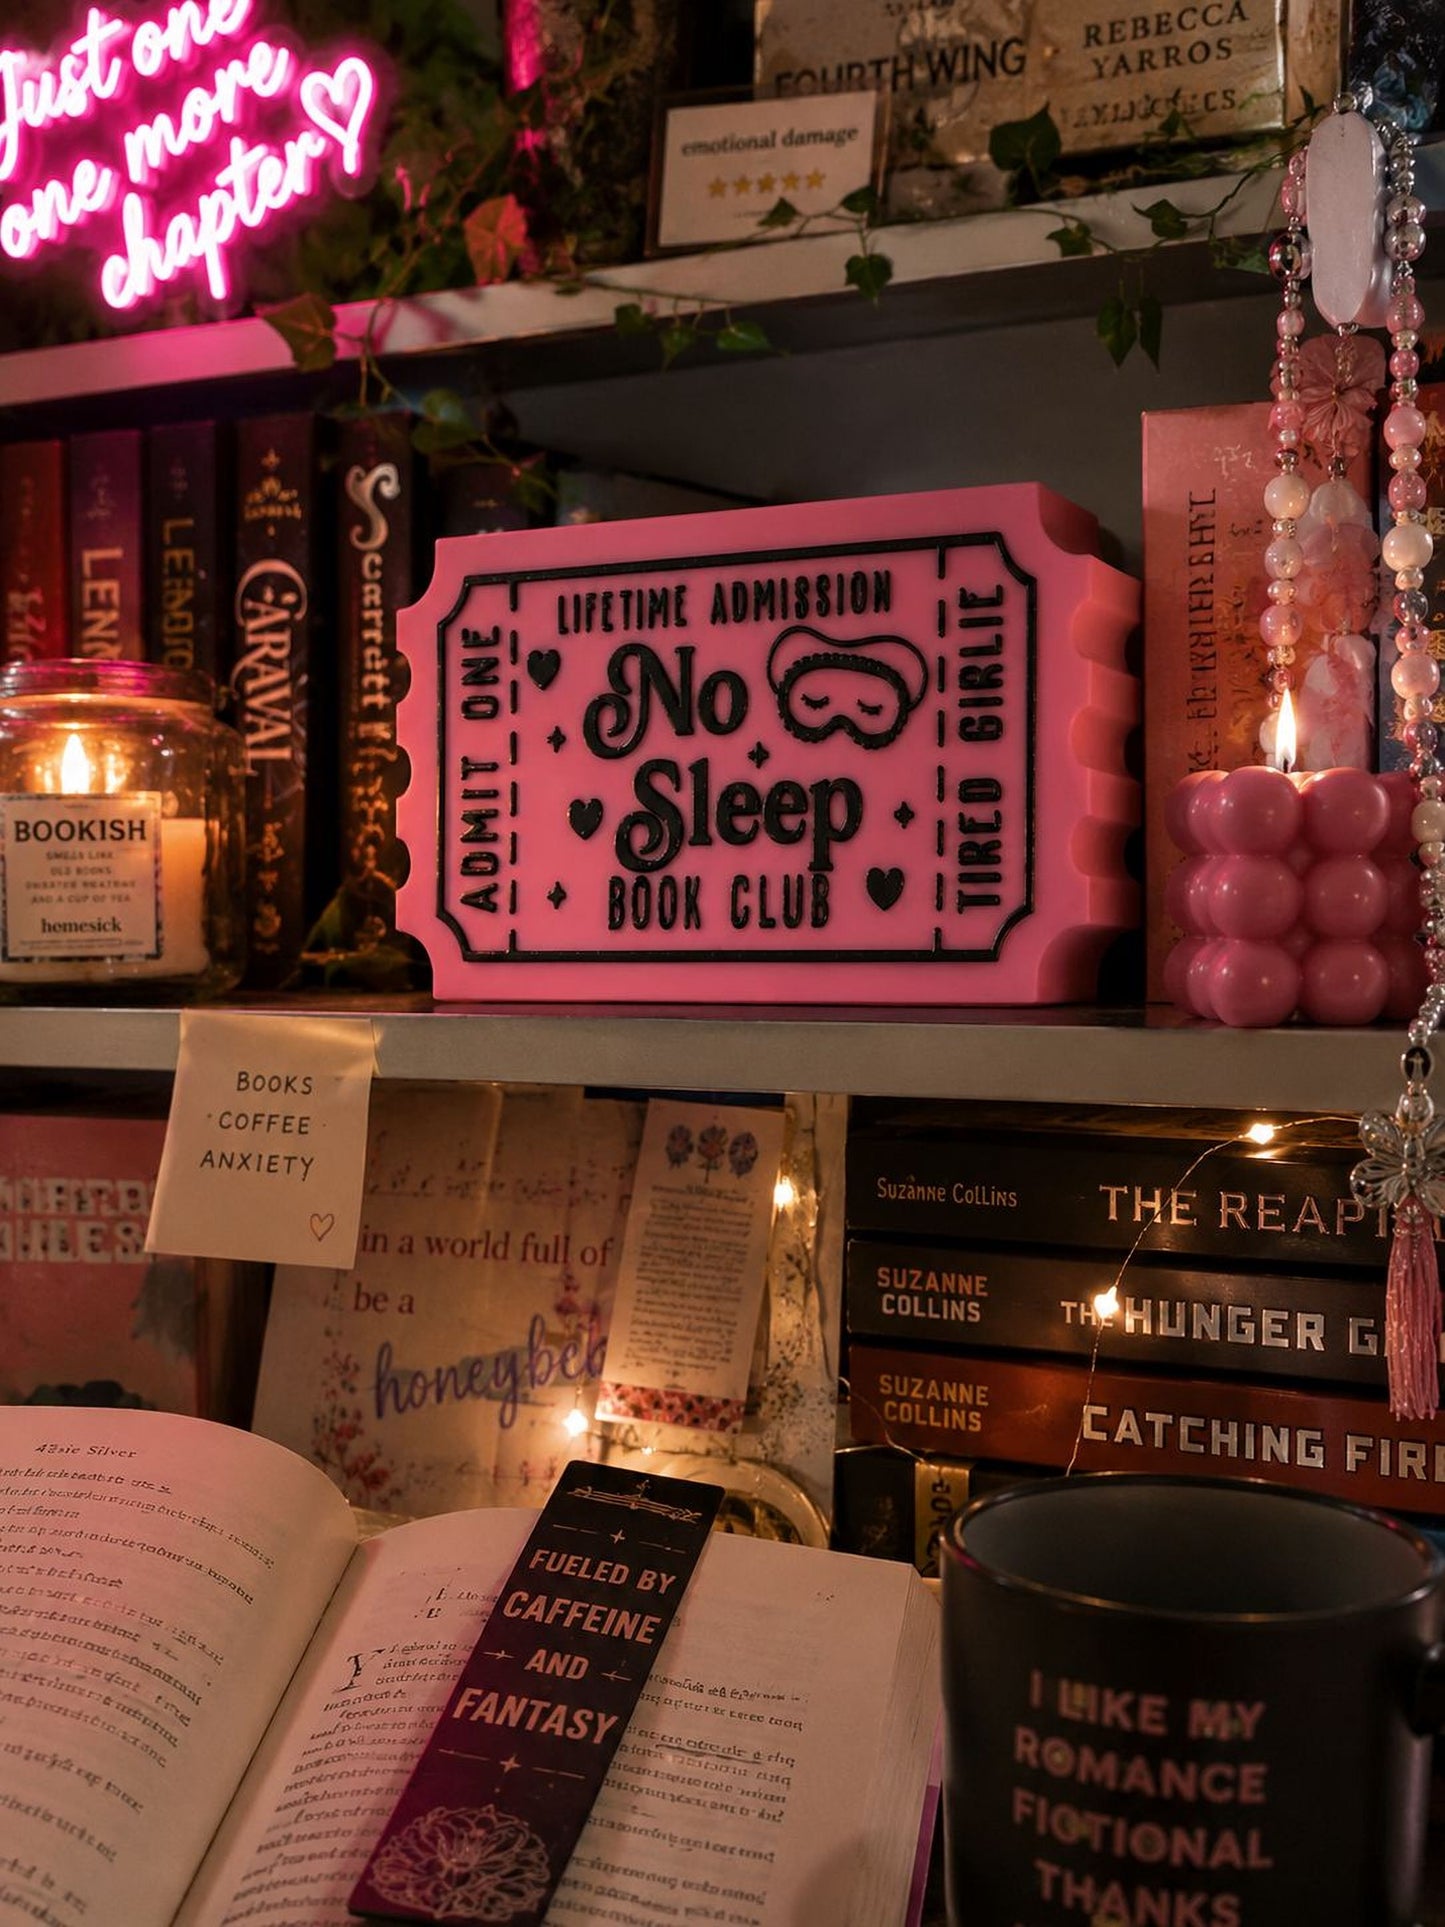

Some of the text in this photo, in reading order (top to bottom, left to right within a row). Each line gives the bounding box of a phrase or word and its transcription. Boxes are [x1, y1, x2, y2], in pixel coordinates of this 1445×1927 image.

[1083, 1, 1249, 48] REBECCA
[774, 37, 1027, 97] FOURTH WING
[1092, 38, 1233, 80] YARROS
[0, 0, 251, 181] Just one
[0, 41, 291, 259] one more
[681, 126, 858, 157] emotional damage
[101, 131, 326, 309] chapter
[557, 570, 891, 635] LIFETIME ADMISSION
[583, 642, 749, 760] No
[460, 624, 500, 914] ADMIT ONE
[957, 584, 1004, 915] TIRED GIRLIE
[14, 819, 147, 842] BOOKISH
[614, 757, 864, 873] Sleep
[41, 917, 122, 934] homesick
[608, 873, 830, 931] BOOK CLUB
[236, 1071, 314, 1095] BOOKS
[218, 1111, 311, 1135] COFFEE
[200, 1150, 315, 1181] ANXIETY
[876, 1177, 1018, 1208] Suzanne Collins
[1099, 1185, 1198, 1227] THE
[361, 1224, 615, 1267] in a world full of
[353, 1282, 415, 1315] be a
[877, 1267, 989, 1297] SUZANNE
[881, 1293, 982, 1323] COLLINS
[1125, 1296, 1326, 1352] HUNGER
[879, 1374, 990, 1406] SUZANNE
[883, 1401, 983, 1432] COLLINS
[1082, 1404, 1326, 1469] CATCHING
[87, 1445, 137, 1458] Silver
[529, 1549, 678, 1596] FUELED BY
[502, 1591, 663, 1644] CAFFEINE
[523, 1648, 590, 1681] AND
[451, 1687, 620, 1745] FANTASY
[1029, 1668, 1267, 1742] I LIKE MY
[1013, 1723, 1269, 1804] ROMANCE
[1011, 1785, 1274, 1870] FICTIONAL
[1033, 1856, 1243, 1927] THANKS
